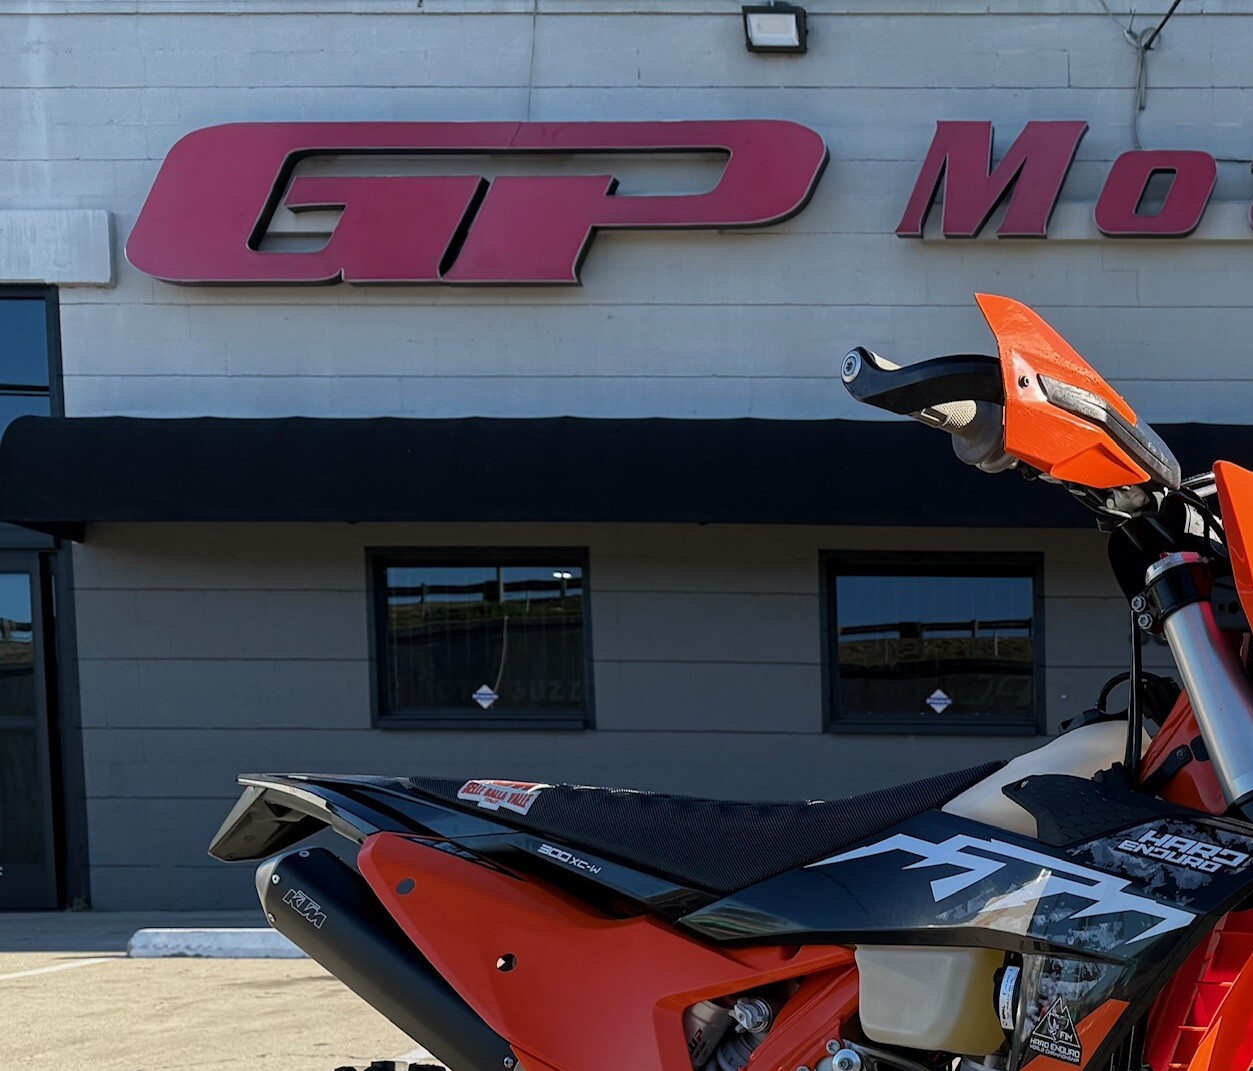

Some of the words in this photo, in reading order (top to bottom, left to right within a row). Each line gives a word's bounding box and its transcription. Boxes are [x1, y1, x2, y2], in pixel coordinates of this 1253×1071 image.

[125, 119, 830, 286] GP
[537, 843, 572, 862] 300
[568, 856, 601, 875] XC-W
[1117, 839, 1222, 873] ENDURO
[1138, 829, 1250, 867] HARD
[282, 888, 327, 929] KTM
[1030, 1037, 1050, 1049] HARD
[1050, 1042, 1080, 1058] ENDURO
[1059, 1031, 1073, 1043] FIM
